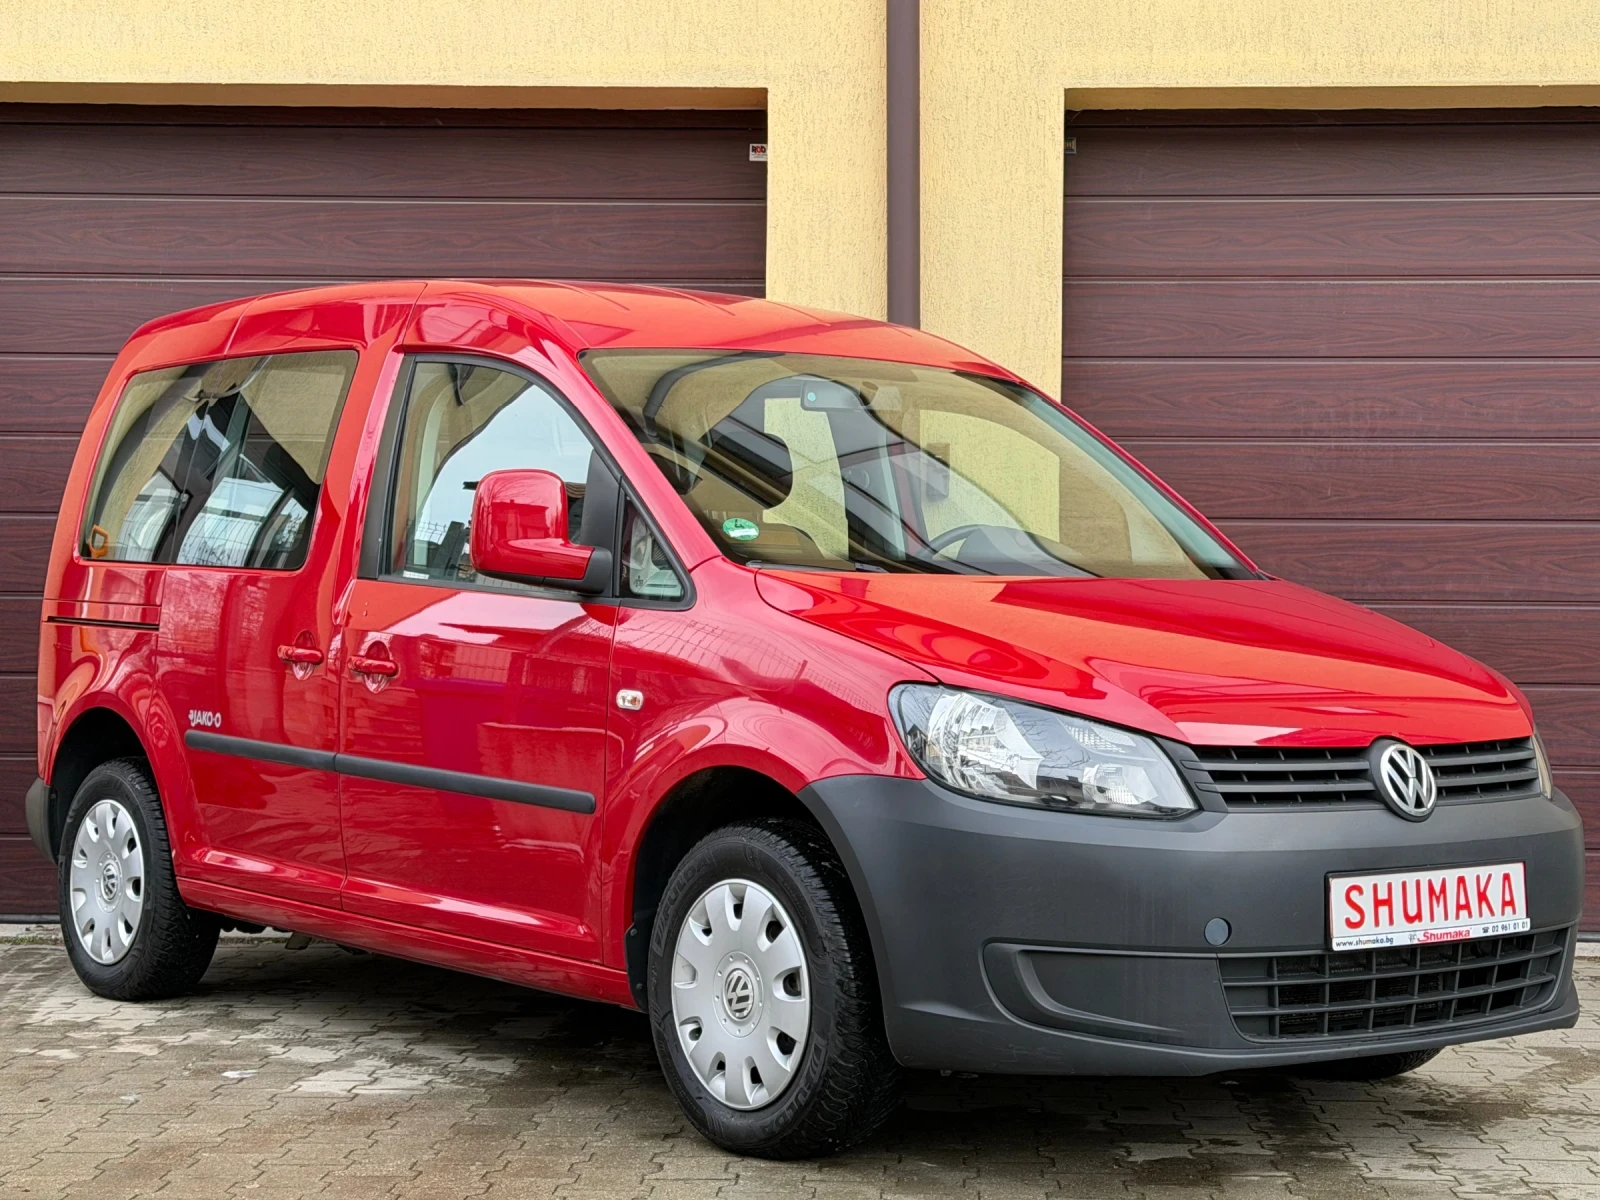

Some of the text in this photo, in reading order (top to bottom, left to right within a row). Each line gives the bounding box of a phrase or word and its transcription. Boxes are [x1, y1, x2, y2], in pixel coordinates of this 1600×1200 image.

[1344, 872, 1517, 930] SHUMAKA
[1335, 935, 1394, 948] www.shumaka.bg
[1419, 928, 1471, 943] Shumaka
[1513, 922, 1520, 930] 01
[1522, 920, 1528, 929] 01
